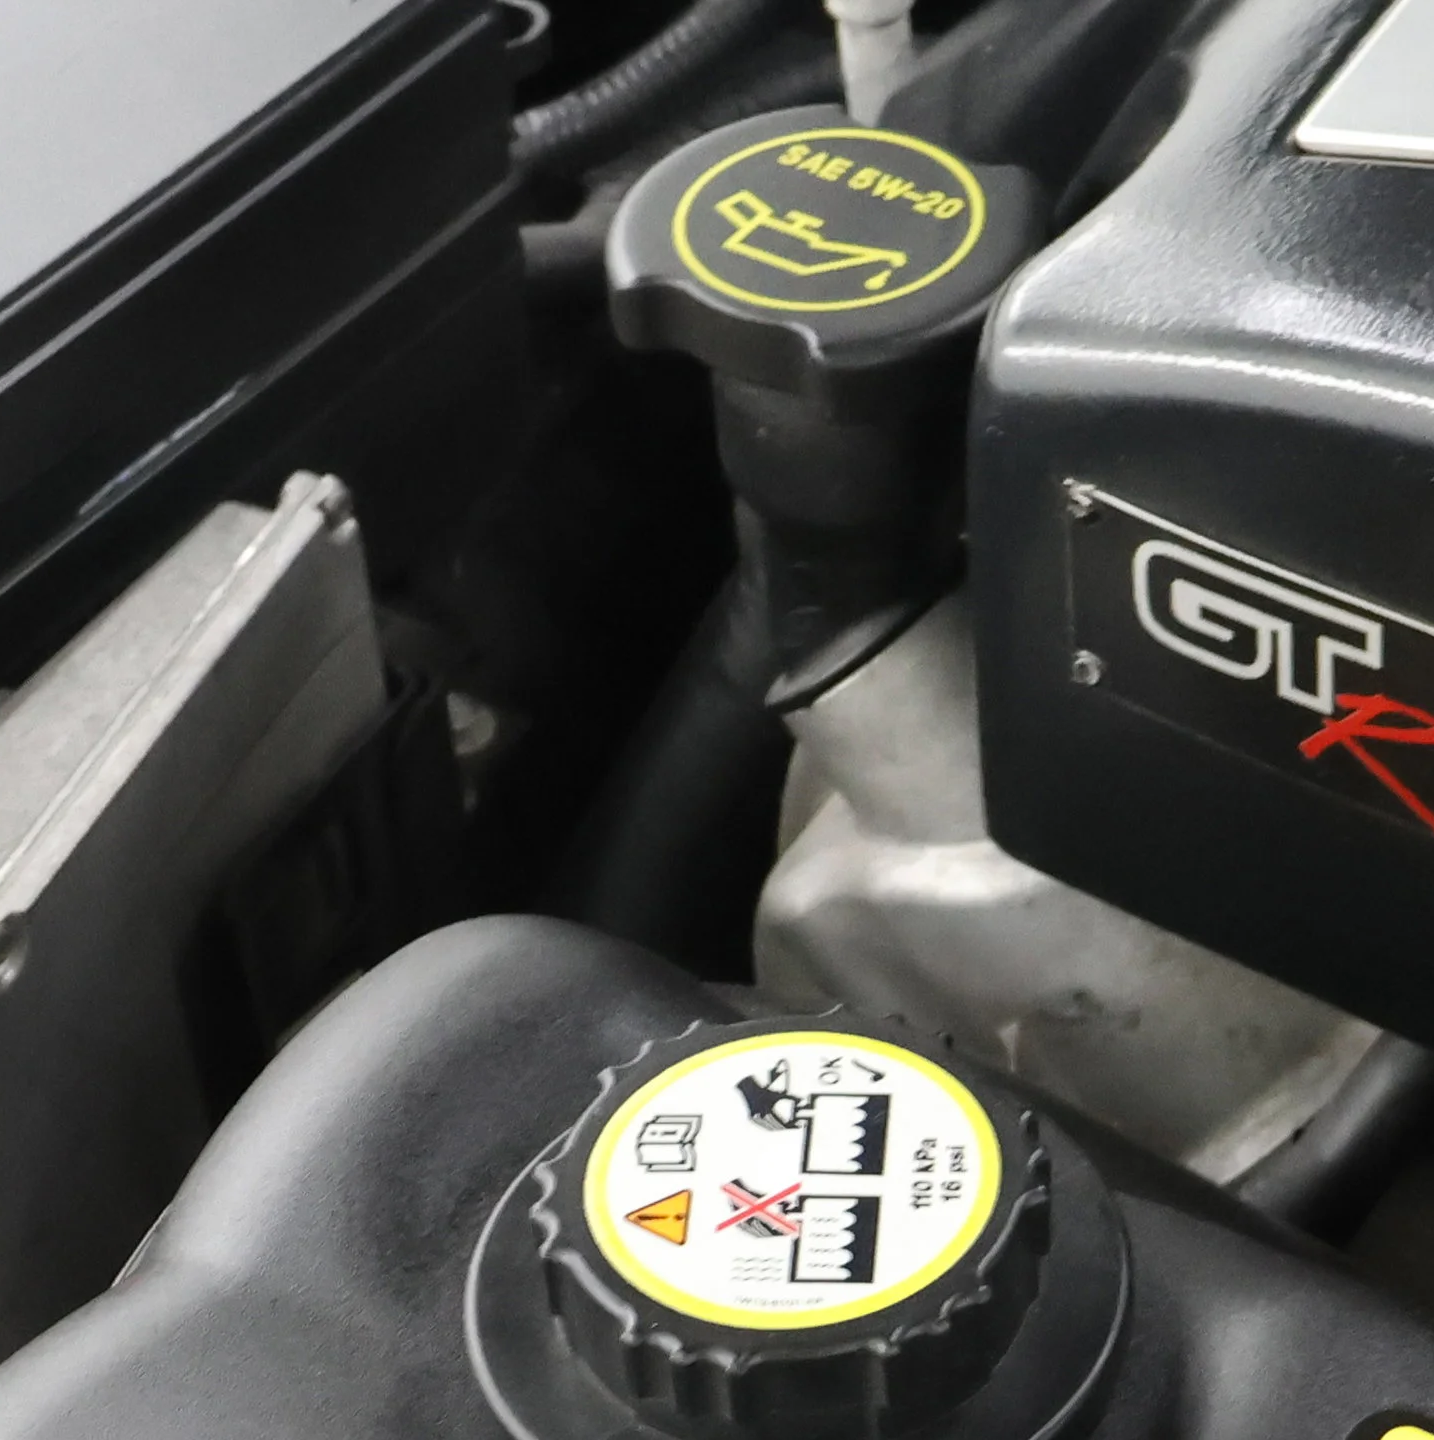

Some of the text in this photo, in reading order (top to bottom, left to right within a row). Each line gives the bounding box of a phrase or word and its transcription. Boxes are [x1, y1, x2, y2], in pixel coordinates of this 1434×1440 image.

[777, 144, 965, 220] SAE 5W-20
[817, 1055, 845, 1086] OK
[909, 1137, 939, 1211] 110 kPa
[940, 1144, 968, 1203] 16 psi
